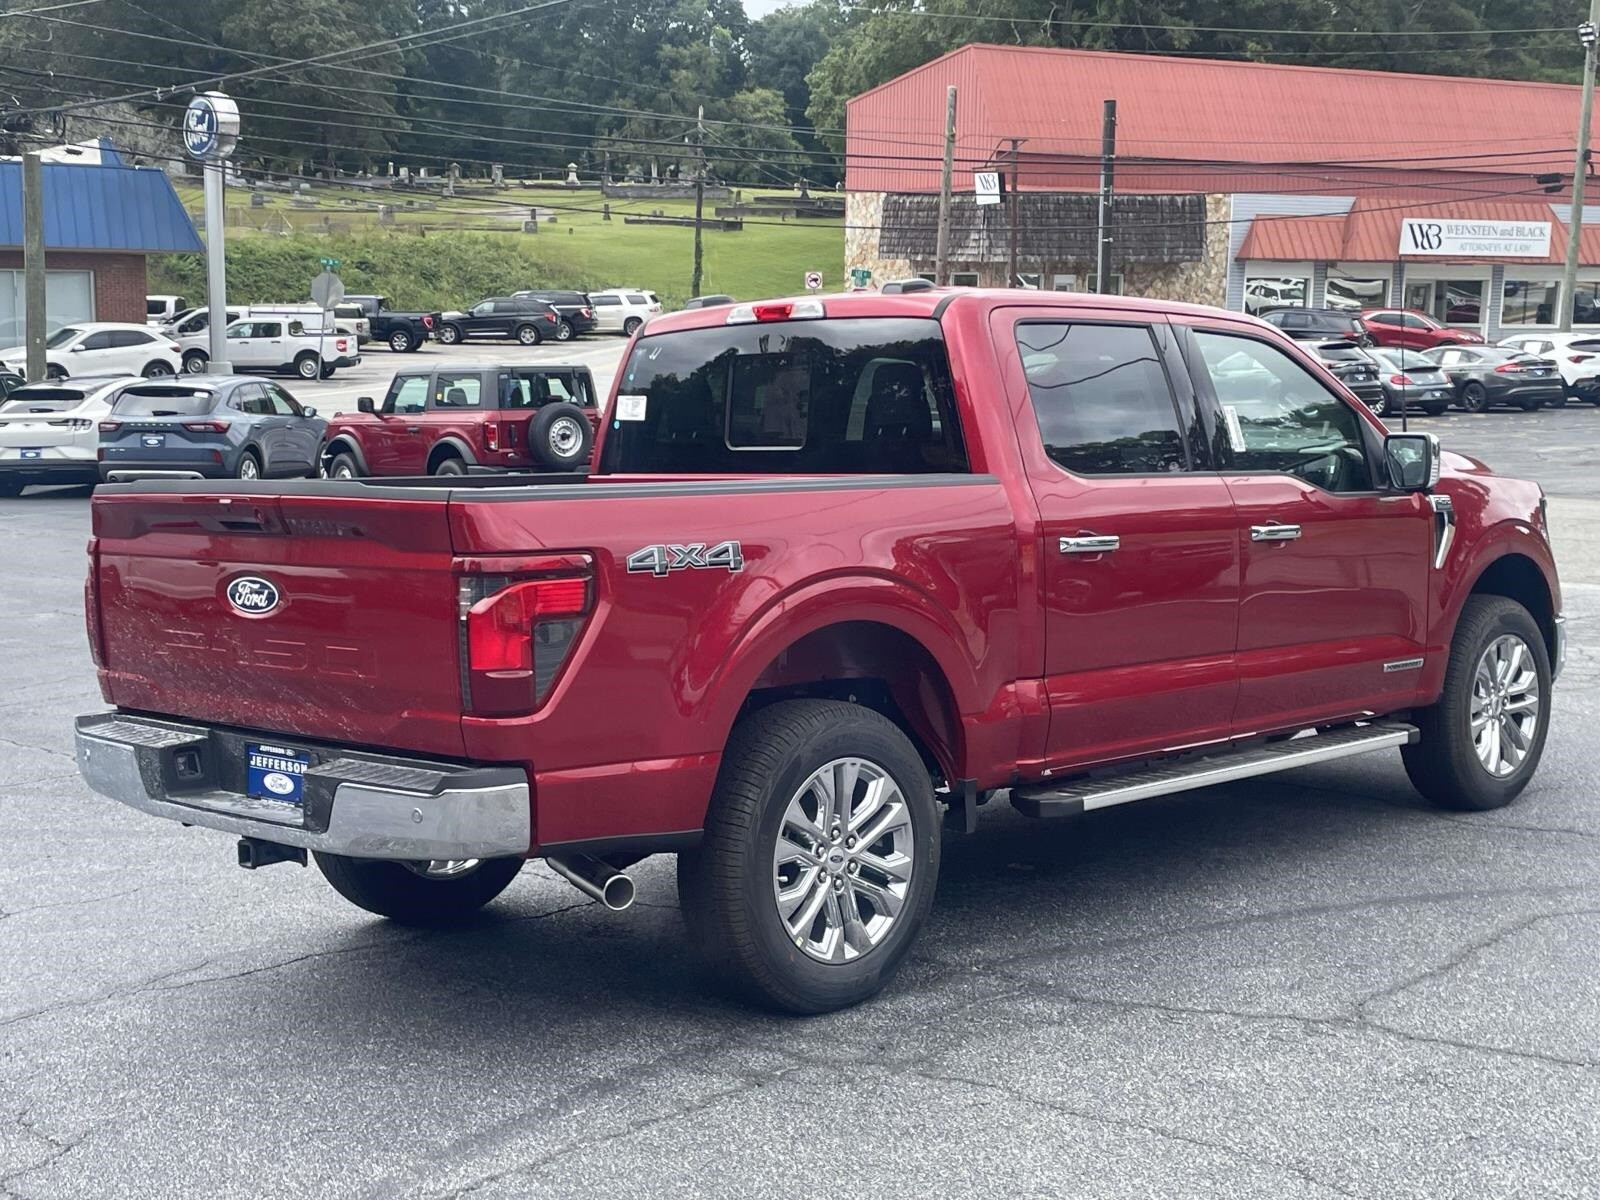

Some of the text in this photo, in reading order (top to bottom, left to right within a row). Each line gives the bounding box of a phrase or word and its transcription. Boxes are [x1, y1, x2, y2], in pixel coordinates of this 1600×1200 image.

[1446, 224, 1546, 238] WEINSTEIN and BLACK
[1459, 242, 1501, 252] ATTORNEYS
[235, 581, 269, 607] Ford
[250, 756, 308, 774] JEFFERSON
